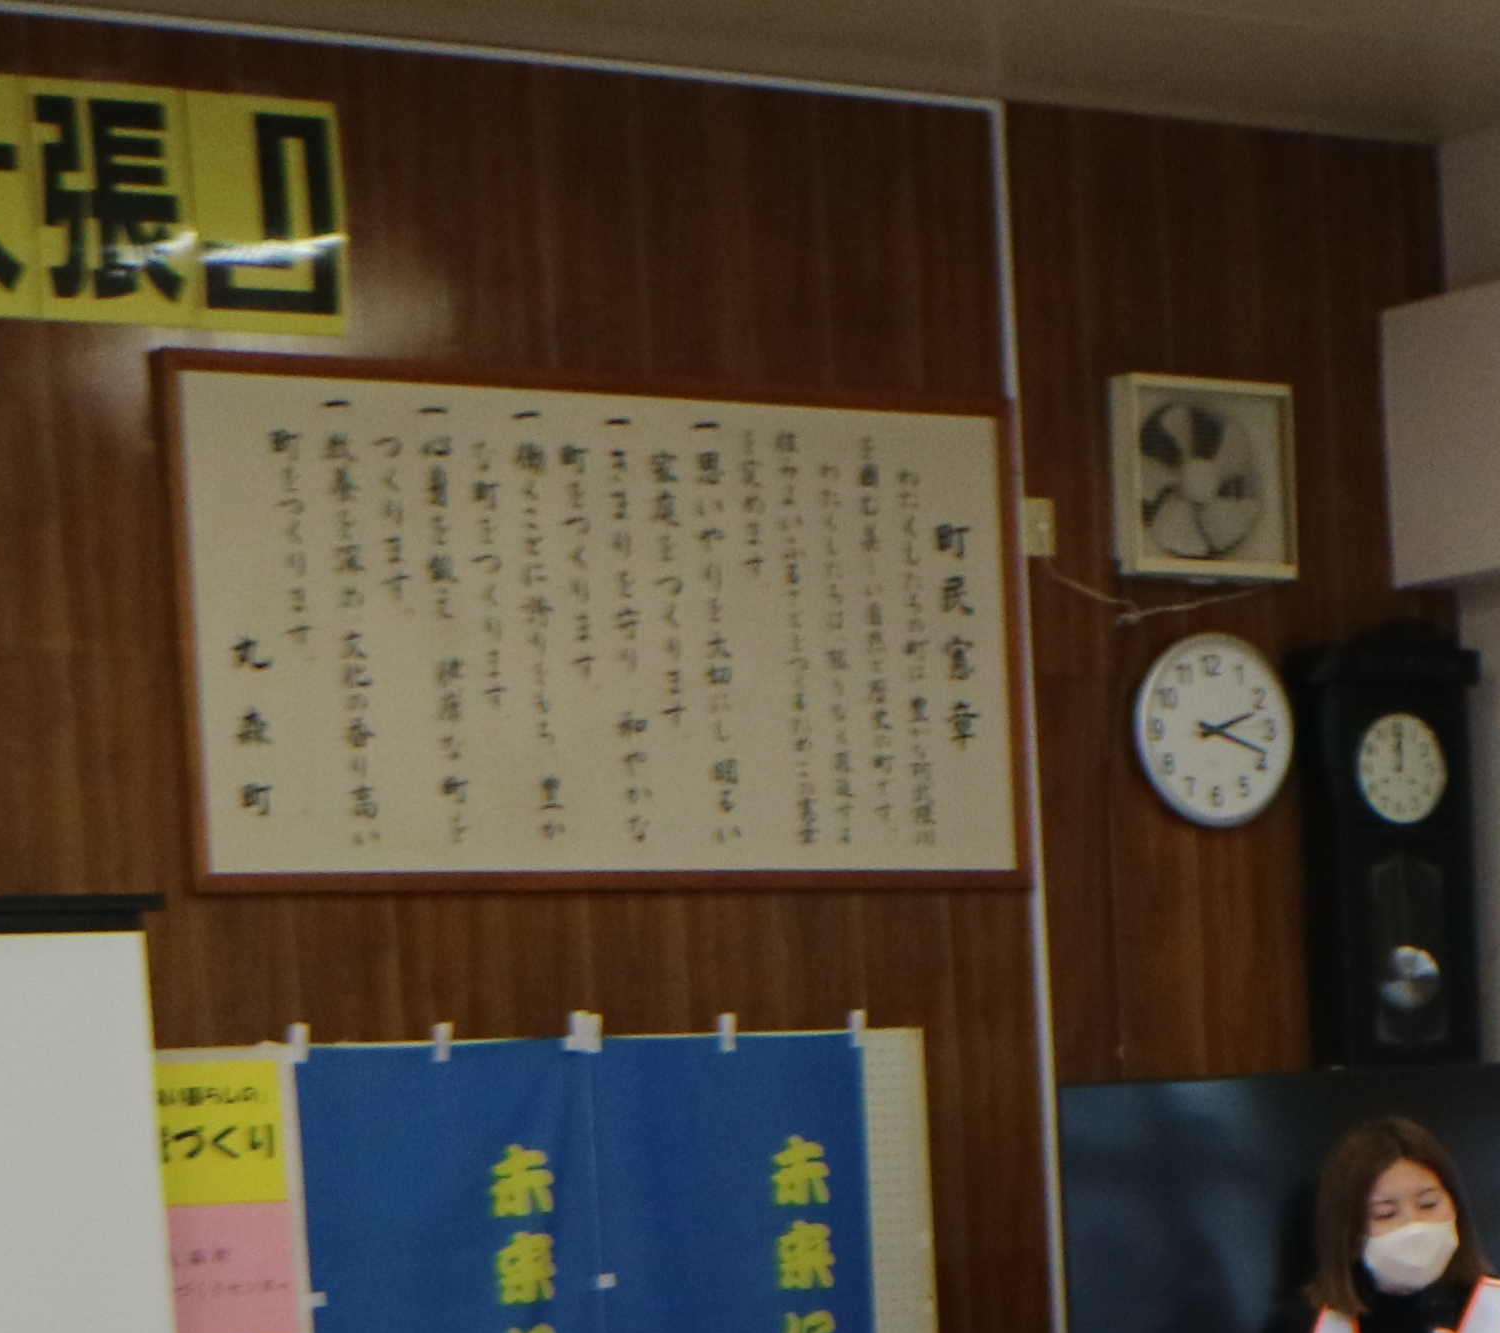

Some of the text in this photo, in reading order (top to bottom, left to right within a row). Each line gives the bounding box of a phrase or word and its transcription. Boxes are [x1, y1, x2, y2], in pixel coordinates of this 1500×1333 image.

[226, 632, 275, 821] 丸森町
[930, 520, 983, 752] 町民憲章
[1201, 652, 1221, 678] 12
